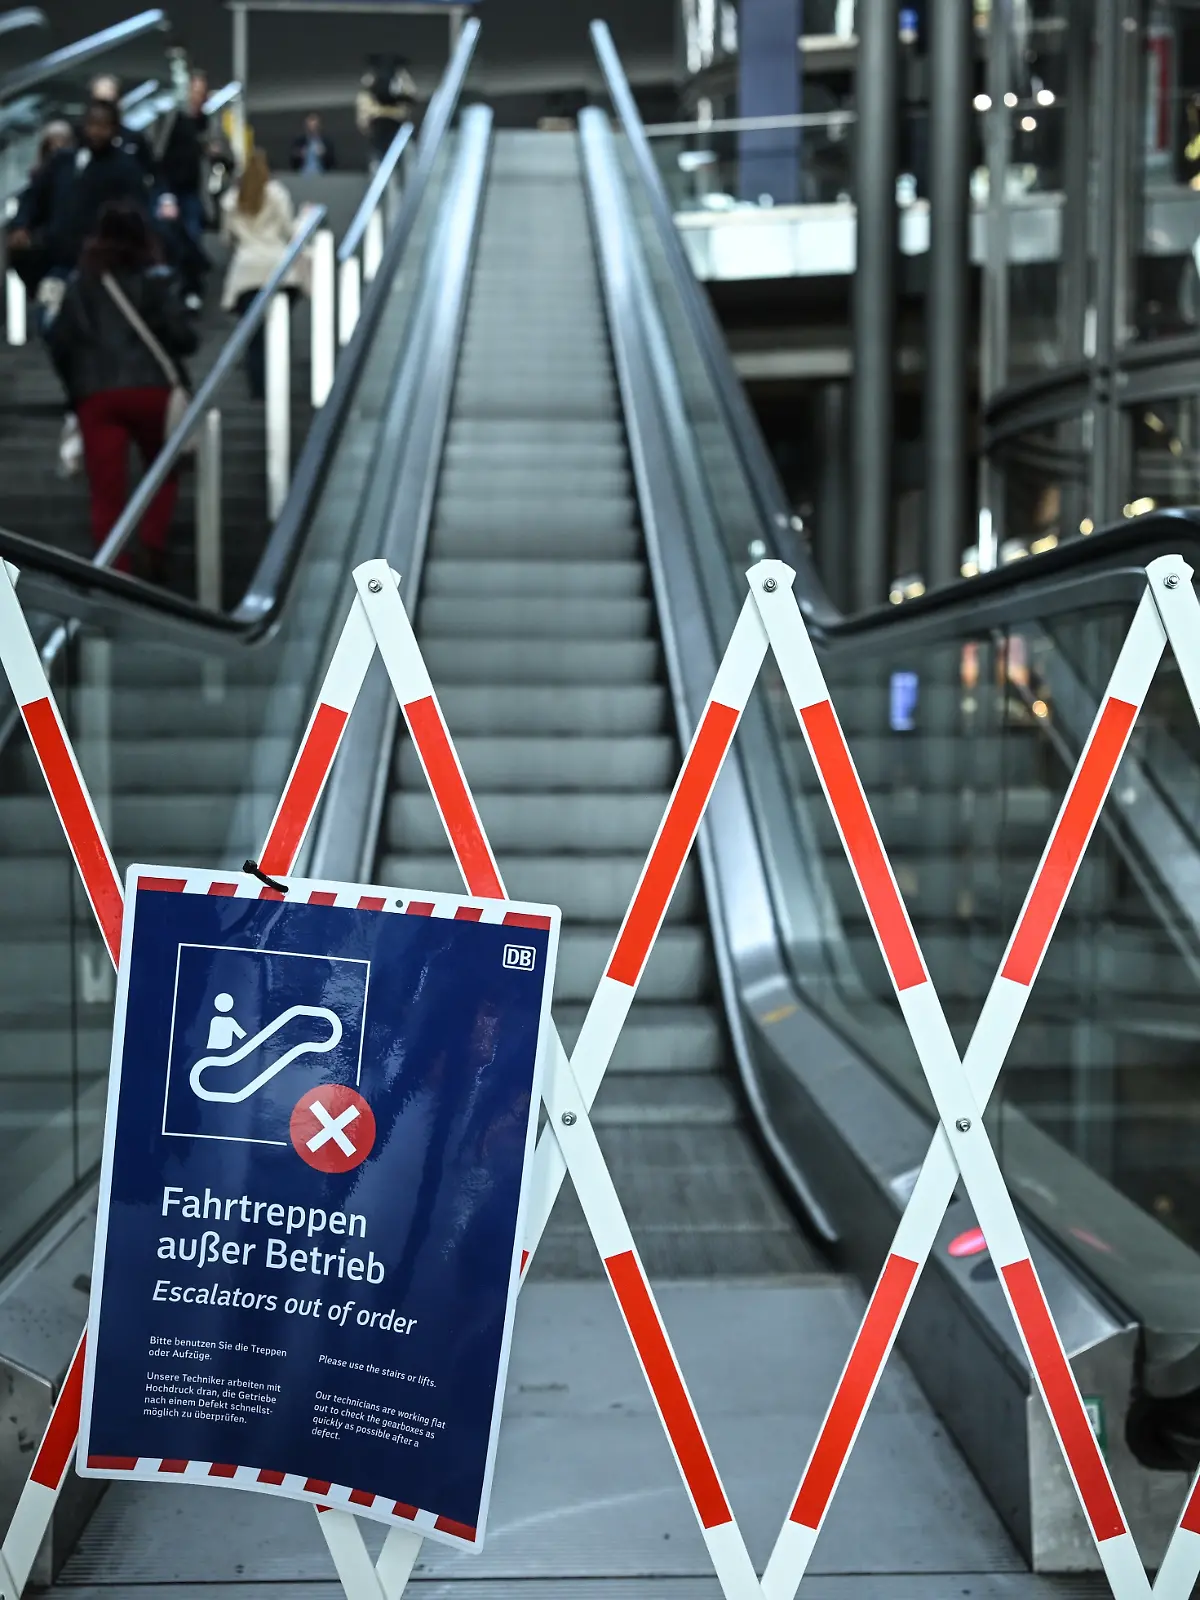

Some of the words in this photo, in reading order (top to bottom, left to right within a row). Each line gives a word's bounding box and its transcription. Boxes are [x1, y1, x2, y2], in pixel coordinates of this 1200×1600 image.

[506, 947, 532, 967] DB
[162, 1186, 366, 1238] Fahrtreppen
[156, 1231, 256, 1268] außer
[266, 1238, 384, 1284] Betrieb
[152, 1280, 277, 1311] Escalators
[284, 1298, 322, 1318] out
[328, 1301, 355, 1326] of
[356, 1308, 417, 1335] order
[150, 1336, 172, 1345] Bitte
[175, 1337, 216, 1348] benutzen
[219, 1341, 232, 1350] Sie
[235, 1343, 248, 1351] die
[251, 1345, 286, 1356] Treppen
[172, 1350, 212, 1361] Aufzüge.
[319, 1355, 347, 1367] Please
[349, 1362, 364, 1370] use
[366, 1364, 380, 1373] the
[382, 1368, 405, 1380] stairs
[418, 1375, 436, 1388] lifts.
[147, 1372, 179, 1381] Unsere
[182, 1374, 225, 1385] Techniker
[228, 1378, 264, 1389] arbeiten
[267, 1384, 281, 1392] mit
[146, 1384, 193, 1394] Hochdruck
[197, 1387, 219, 1398] dran,
[222, 1390, 235, 1398] die
[239, 1391, 276, 1403] Getriebe
[144, 1408, 179, 1418] möglich
[195, 1411, 247, 1423] überprüfen.
[145, 1396, 166, 1404] nach
[169, 1397, 195, 1406] einem
[198, 1399, 228, 1409] Defekt
[231, 1403, 273, 1415] schnellst-
[316, 1391, 331, 1400] Our
[334, 1395, 380, 1412] technicians
[382, 1407, 396, 1416] are
[398, 1410, 429, 1425] working
[431, 1417, 446, 1429] flat
[312, 1427, 340, 1440] defect.
[313, 1416, 343, 1429] quickly
[356, 1425, 390, 1440] possible
[392, 1434, 412, 1445] after
[341, 1409, 365, 1420] check
[367, 1415, 380, 1424] the
[382, 1419, 424, 1435] gearboxes
[426, 1431, 435, 1439] as
